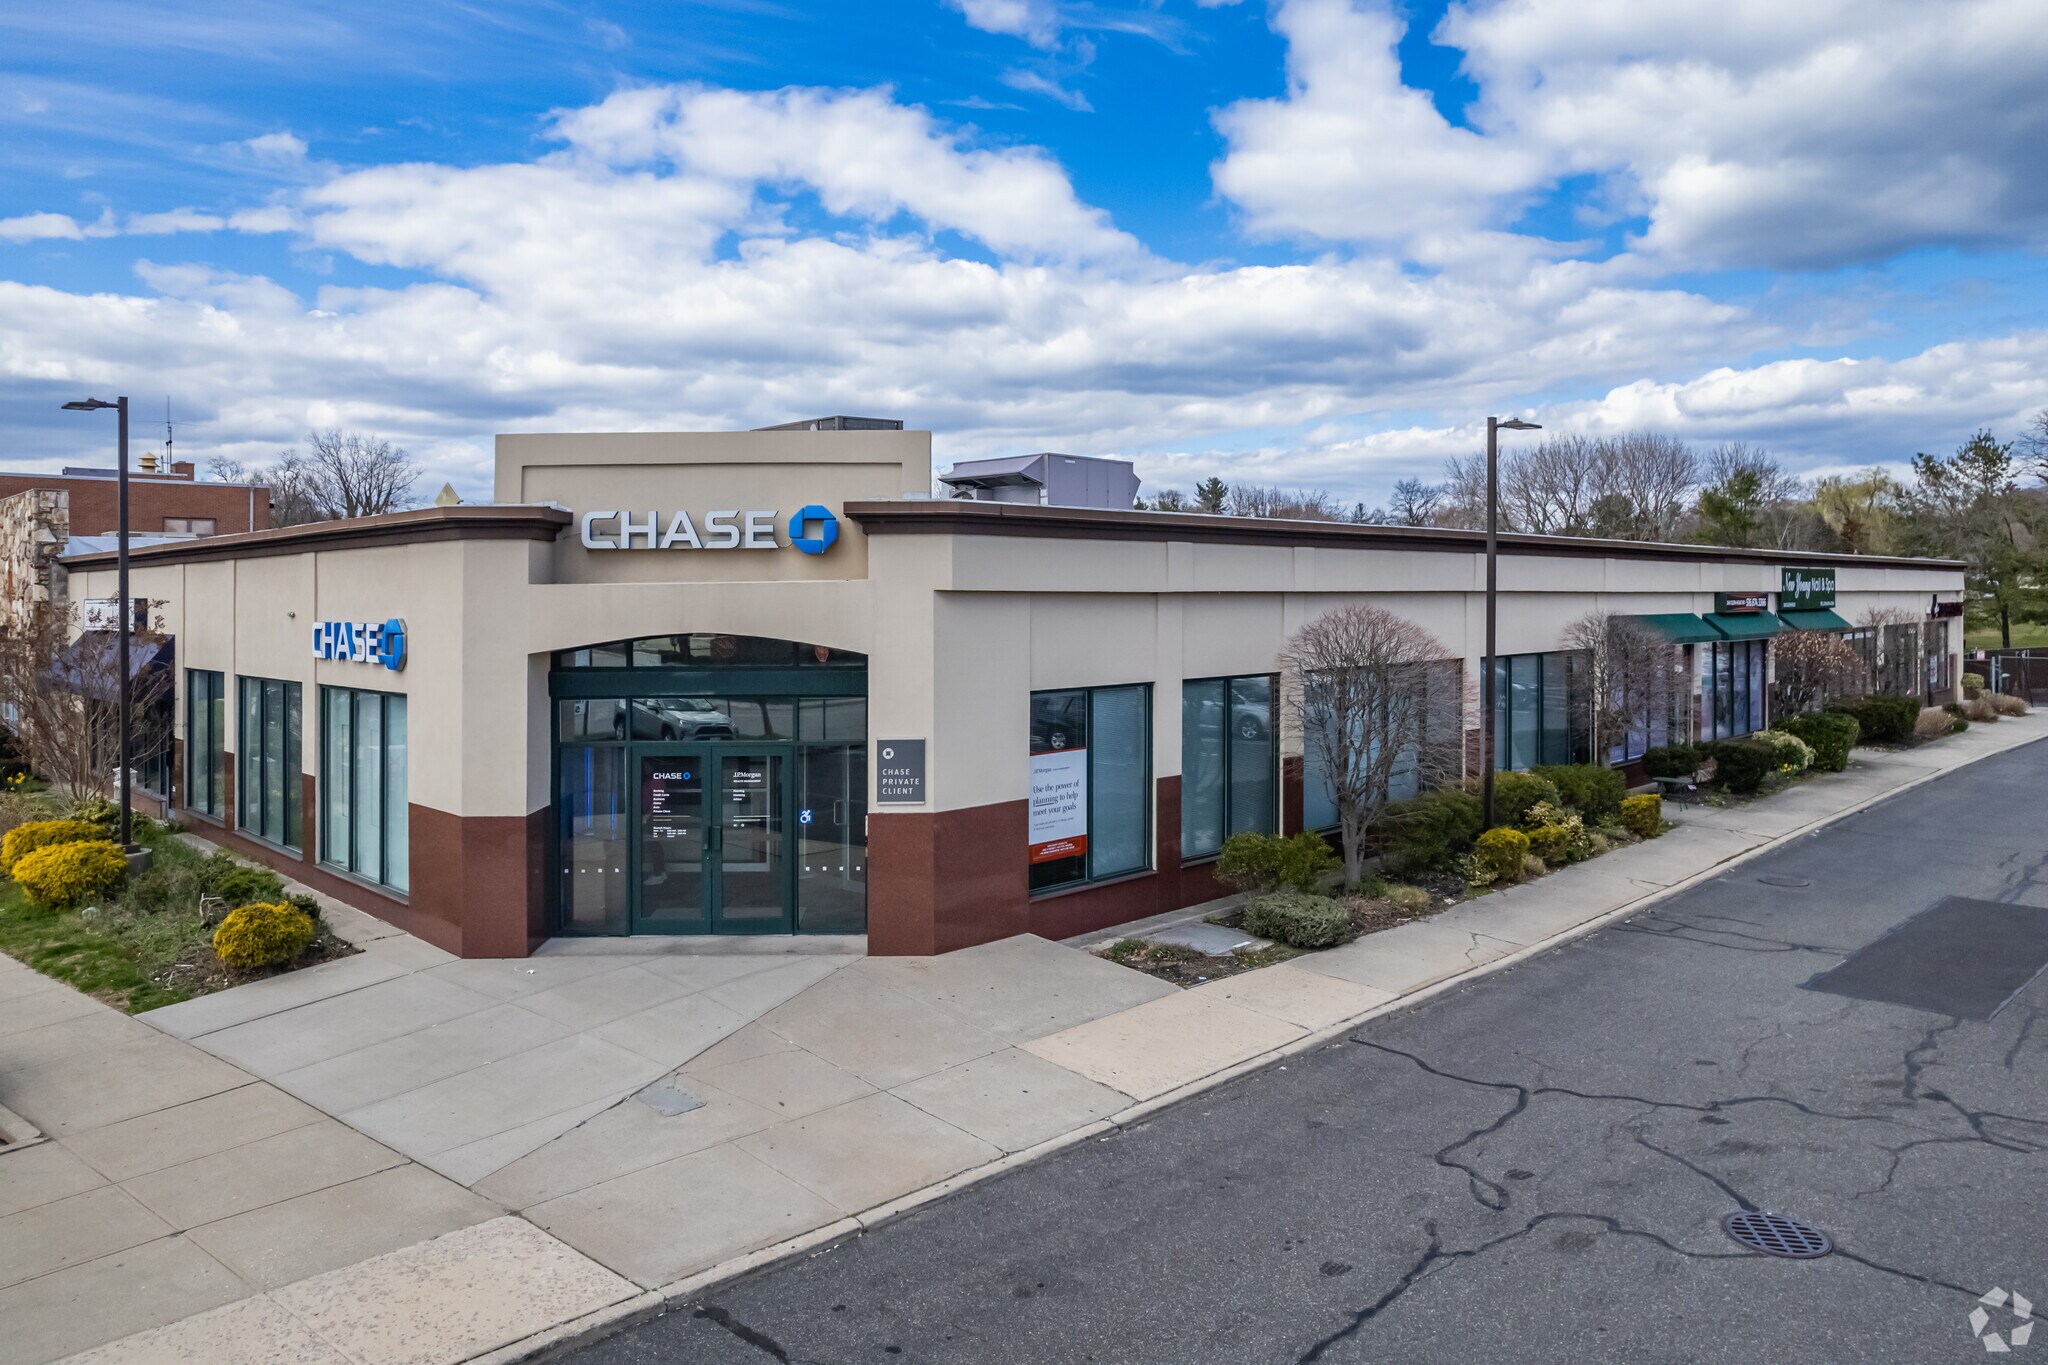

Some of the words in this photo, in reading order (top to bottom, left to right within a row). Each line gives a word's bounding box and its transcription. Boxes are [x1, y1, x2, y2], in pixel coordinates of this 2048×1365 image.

[581, 510, 779, 549] CHASE
[1812, 578, 1821, 591] Nail
[1826, 578, 1834, 594] Spa
[312, 622, 380, 663] CHASE
[882, 787, 913, 795] CLIENT
[1033, 785, 1043, 793] Use
[1045, 783, 1054, 792] the
[1055, 783, 1072, 792] power
[1074, 779, 1079, 787] of
[1033, 796, 1058, 807] planning
[1067, 791, 1078, 800] help
[1048, 807, 1061, 816] your
[1063, 802, 1076, 814] goals
